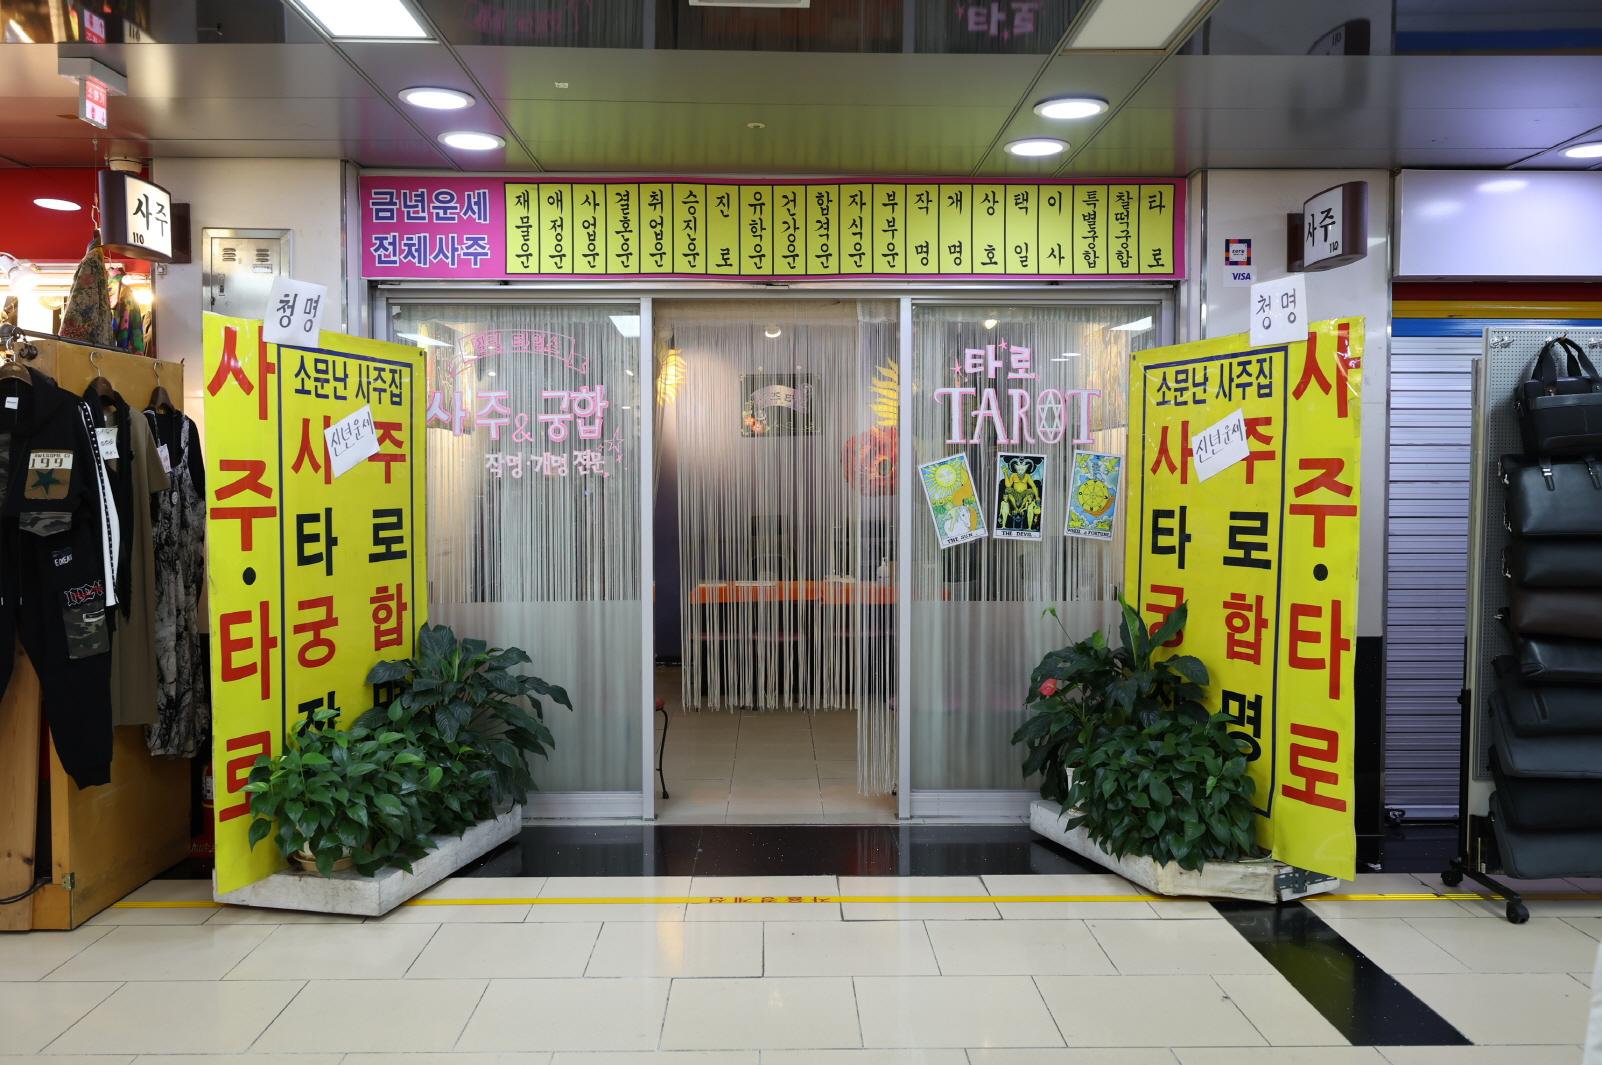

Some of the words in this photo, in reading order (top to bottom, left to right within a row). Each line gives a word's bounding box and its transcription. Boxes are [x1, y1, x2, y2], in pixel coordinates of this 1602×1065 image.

[132, 232, 145, 245] 110
[133, 193, 168, 237] 사주
[370, 187, 490, 223] 금년운세
[516, 190, 532, 268] 재물운
[548, 190, 566, 268] 애정운
[581, 190, 599, 268] 사업운
[615, 190, 632, 268] 결혼운
[648, 189, 666, 267] 취업운
[682, 190, 699, 268] 승진운
[715, 192, 735, 268] 진로
[748, 192, 766, 268] 유학운
[782, 191, 799, 268] 건강운
[815, 191, 833, 268] 합격운
[848, 190, 866, 267] 자식운
[882, 191, 898, 267] 부부운
[914, 190, 932, 266] 작명
[948, 190, 962, 265] 개명
[981, 191, 998, 265] 상호
[1014, 191, 1028, 267] 택일
[1048, 191, 1064, 263] 이사
[1082, 191, 1099, 268] 특별궁합
[1115, 191, 1133, 268] 찰떡궁합
[1148, 190, 1165, 268] 타로
[1305, 207, 1336, 246] 사주
[370, 233, 490, 268] 전체사주
[1231, 272, 1251, 281] VISA
[296, 355, 348, 401] 소문난
[356, 360, 403, 406] 사주집
[964, 344, 1037, 379] 타로
[1155, 366, 1208, 406] 소문난
[1215, 356, 1273, 401] 사주집
[329, 414, 375, 460] 신년운세
[428, 391, 510, 440] 사주
[514, 412, 534, 443] &
[539, 385, 608, 441] 궁합
[934, 387, 1102, 445] TAROT
[1149, 416, 1278, 486] 사주
[1194, 417, 1244, 464] 신년운세
[572, 449, 605, 476] 전문
[207, 326, 277, 821] 사주·타로
[295, 506, 409, 577] 타로
[1150, 504, 1273, 571] 타로
[1282, 323, 1360, 812] 사주·타로
[293, 583, 409, 669] 궁합
[1145, 582, 1269, 667] 궁합
